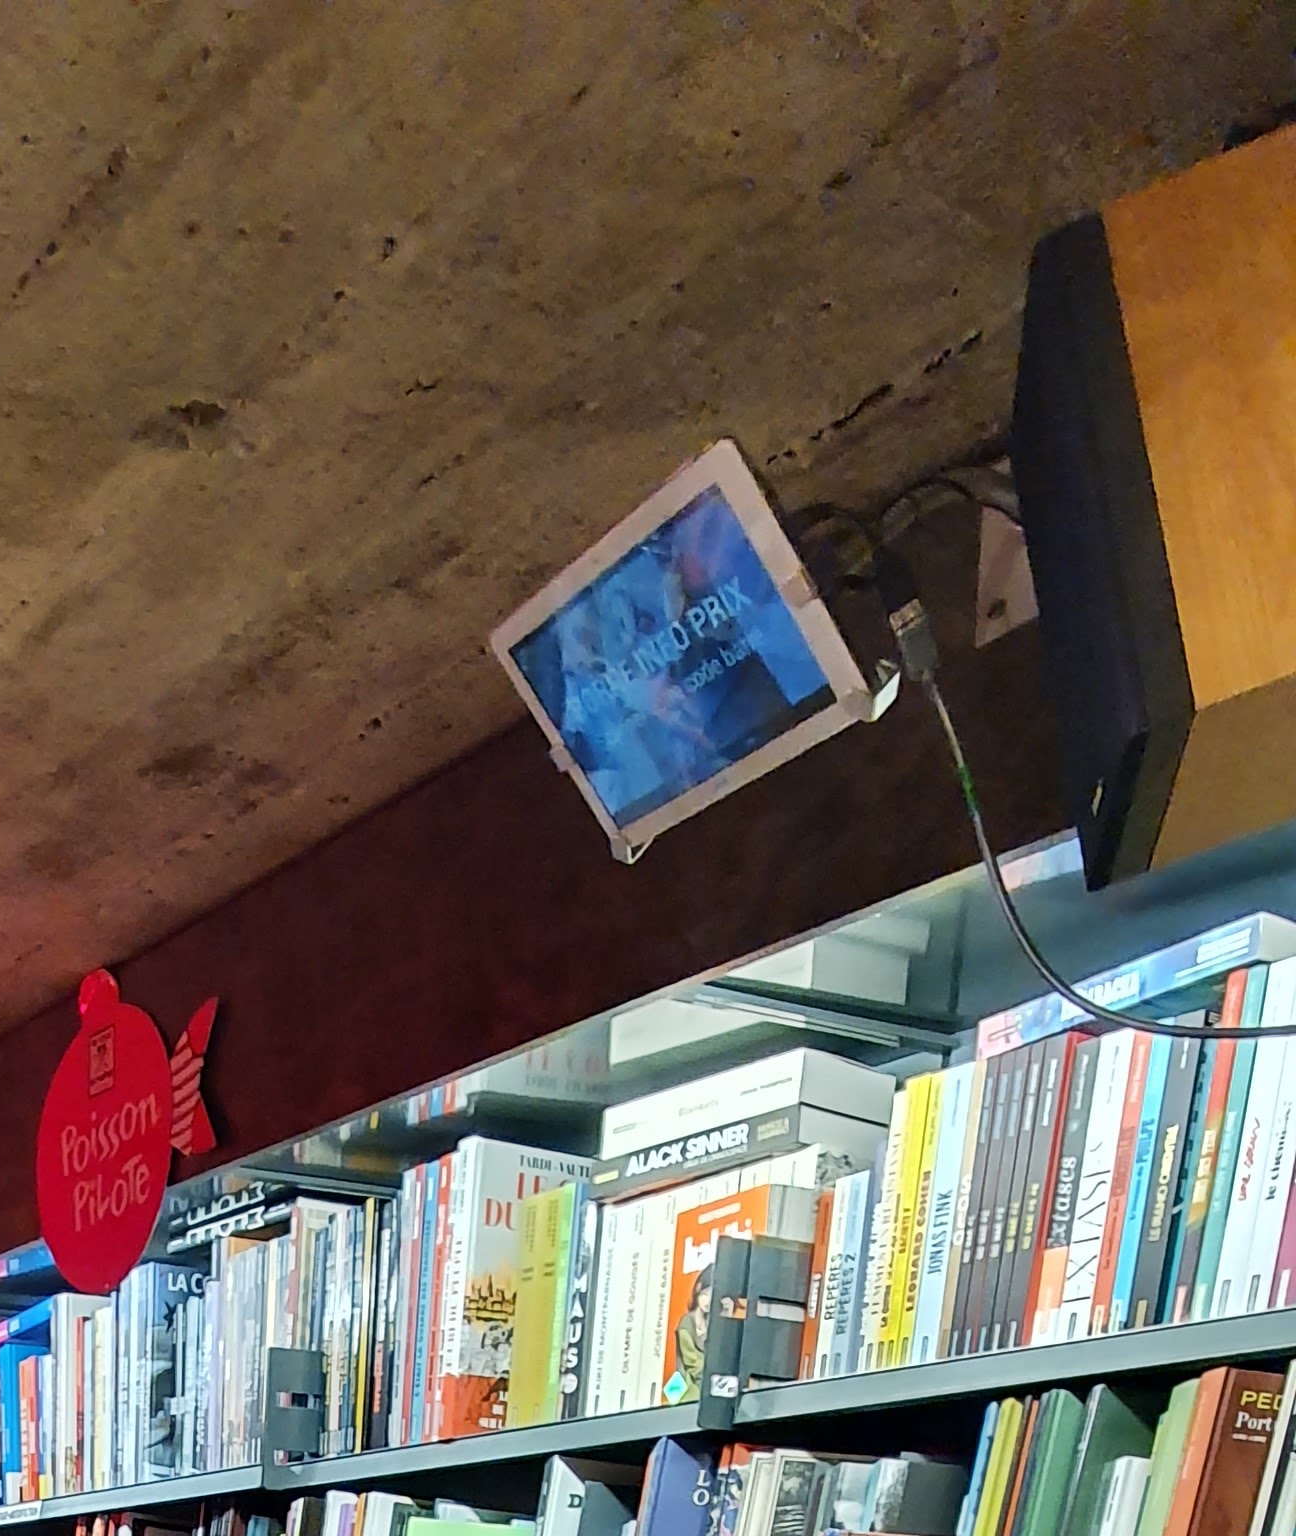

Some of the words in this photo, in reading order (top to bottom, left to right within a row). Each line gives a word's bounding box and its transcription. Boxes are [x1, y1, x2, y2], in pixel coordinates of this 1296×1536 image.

[686, 575, 752, 639] PRIX
[60, 1093, 161, 1177] Poisson
[625, 1142, 685, 1177] ALACK
[683, 1123, 750, 1159] SINNER
[927, 1231, 946, 1276] JONAS
[168, 1271, 189, 1293] LA
